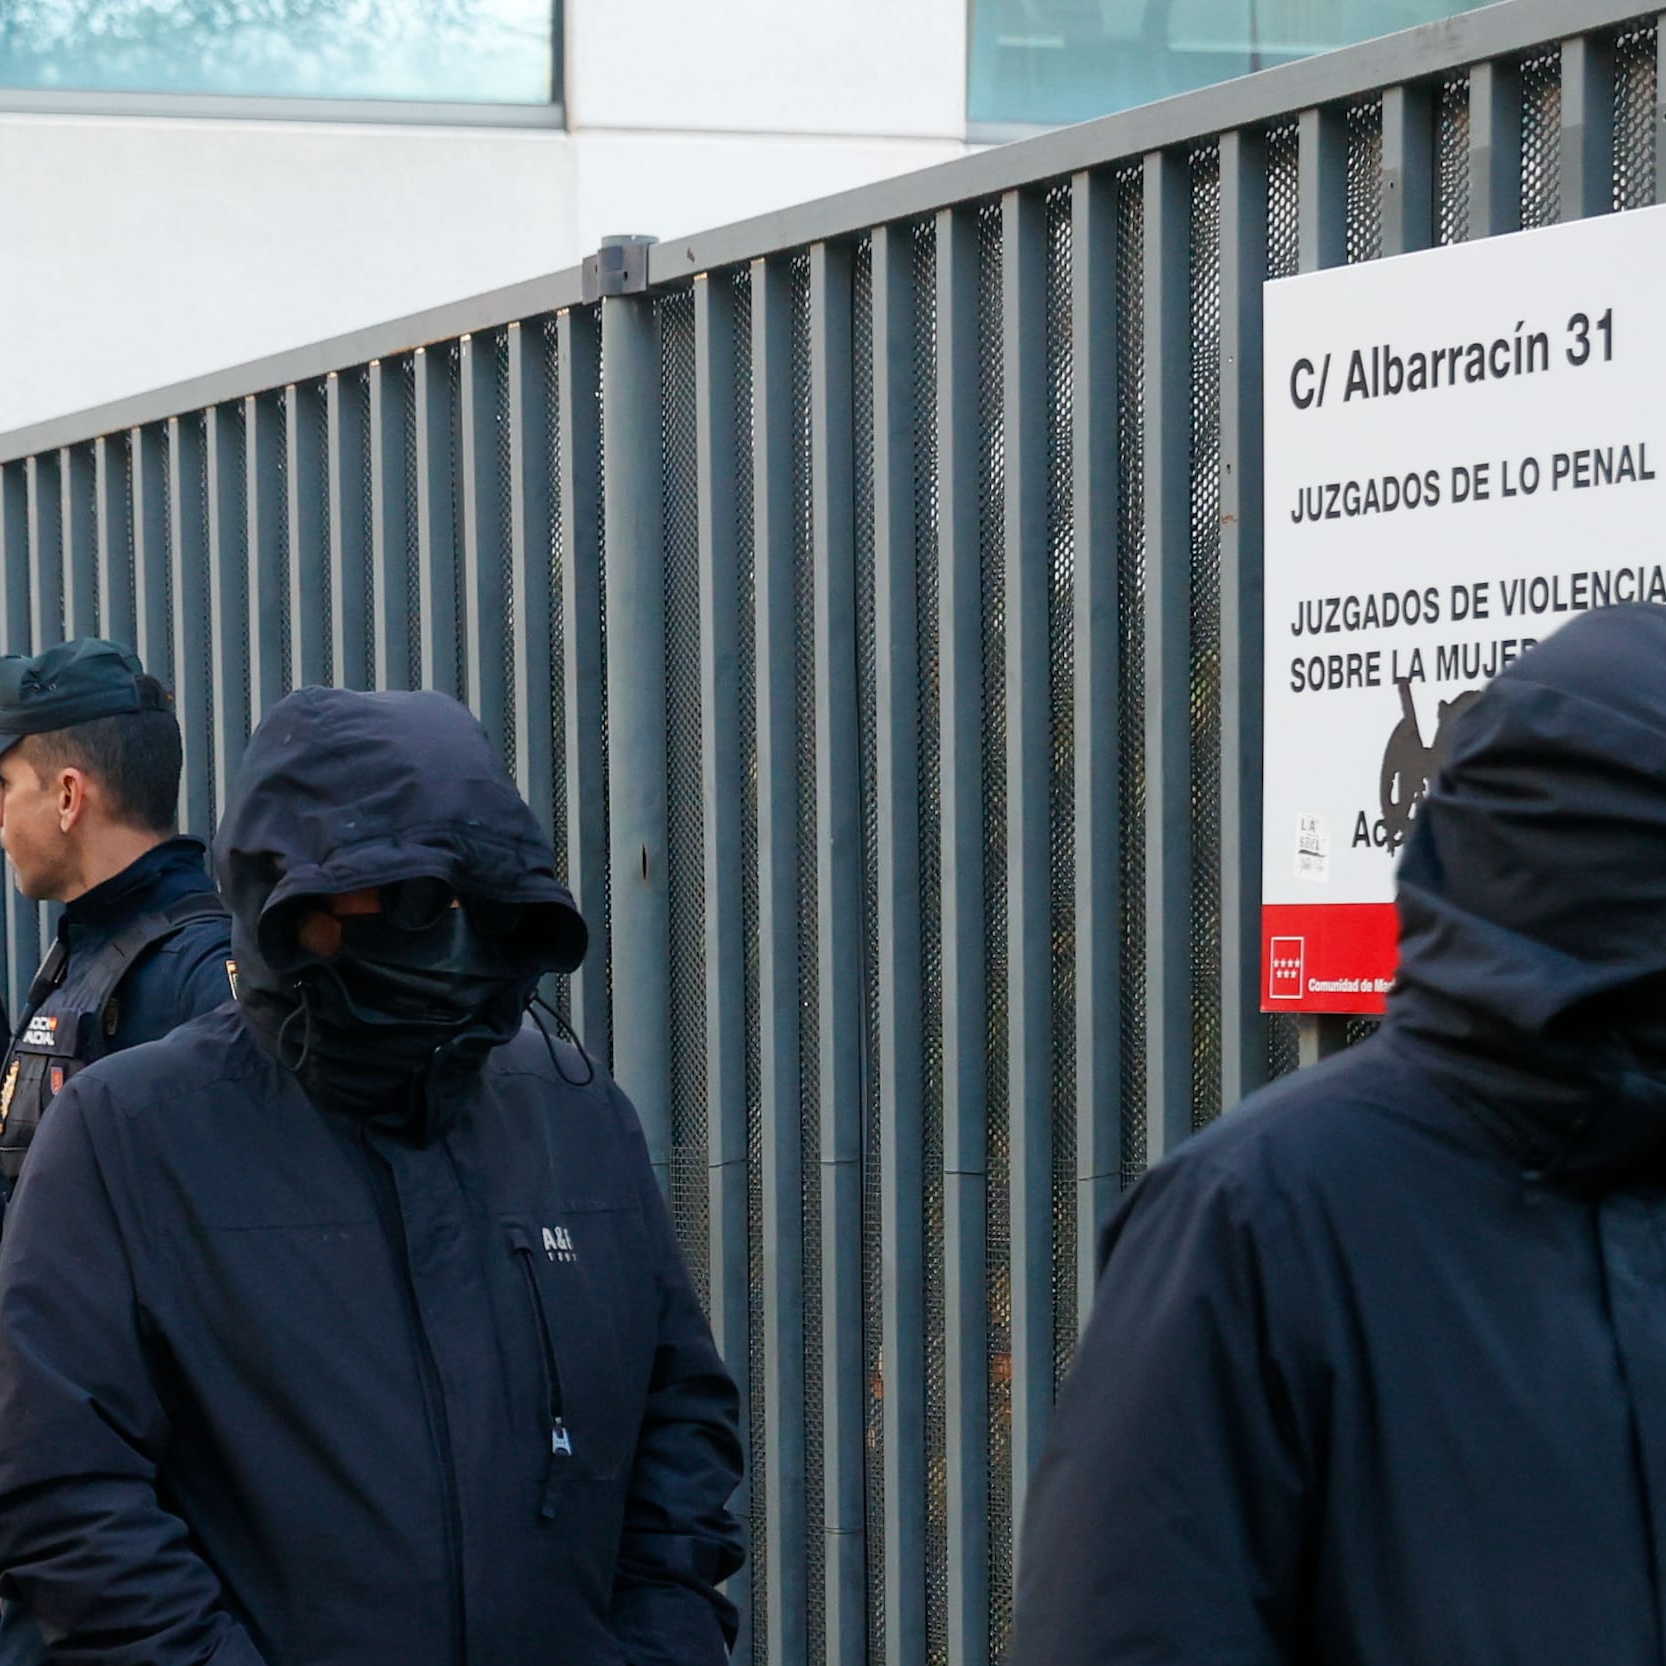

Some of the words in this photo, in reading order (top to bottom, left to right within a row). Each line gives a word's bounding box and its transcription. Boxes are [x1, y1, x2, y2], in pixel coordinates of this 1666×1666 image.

[1289, 353, 1331, 410] C/
[1343, 320, 1550, 403] Albarracín
[1566, 308, 1615, 366] 31
[1290, 469, 1441, 524] JUZGADOS
[1452, 463, 1490, 504] DE
[1501, 456, 1540, 496] LO
[1552, 442, 1656, 491] PENAL
[1290, 587, 1440, 637] JUZGADOS
[1450, 581, 1490, 622] DE
[1290, 649, 1381, 693] SOBRE
[1392, 647, 1427, 686] LA
[1307, 978, 1359, 993] Comunidad
[1360, 978, 1373, 992] de
